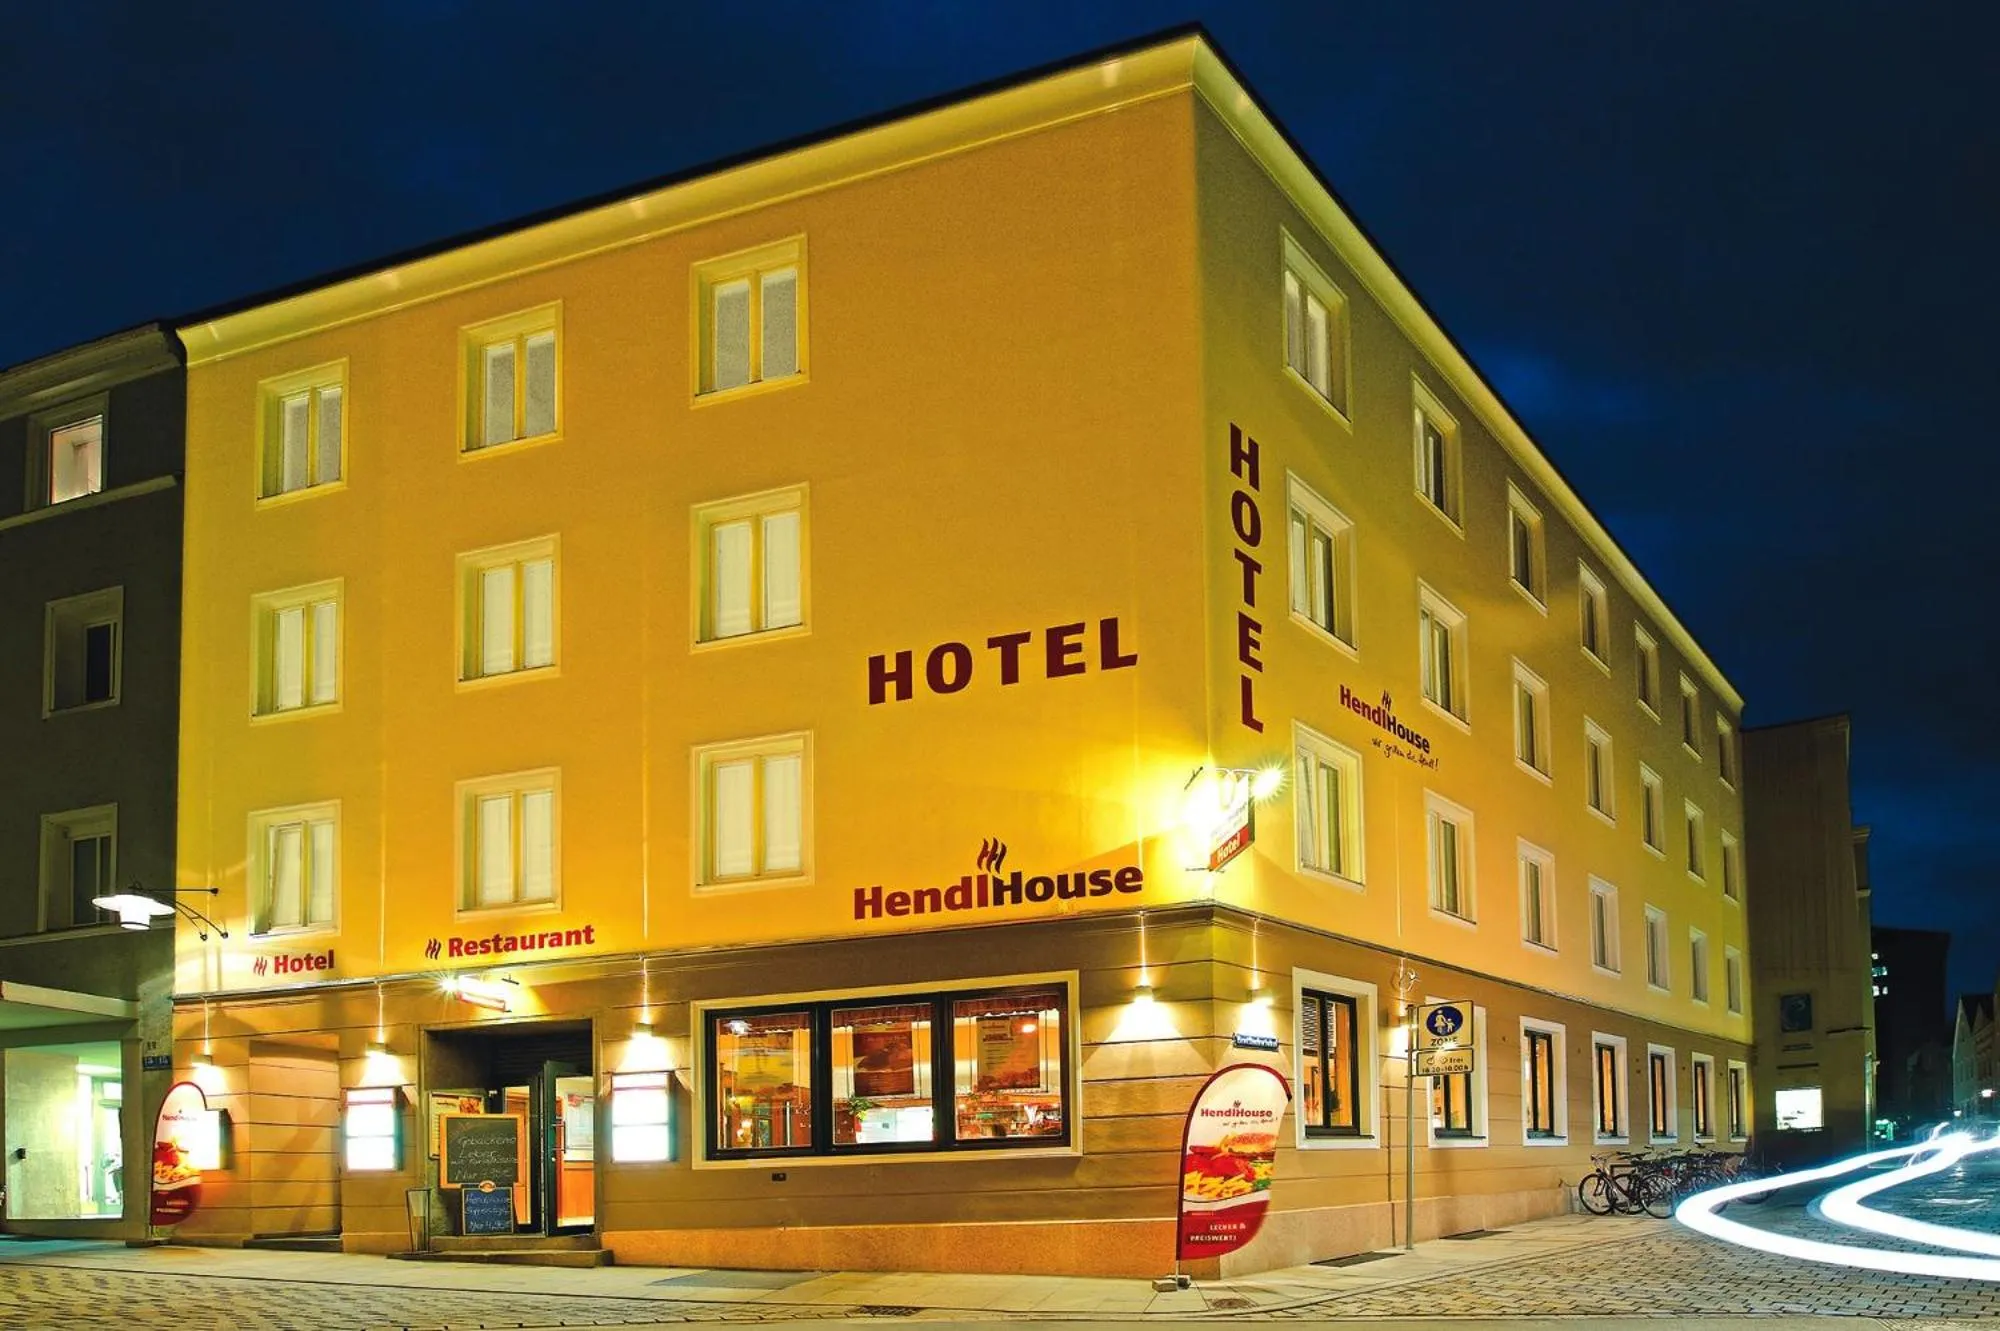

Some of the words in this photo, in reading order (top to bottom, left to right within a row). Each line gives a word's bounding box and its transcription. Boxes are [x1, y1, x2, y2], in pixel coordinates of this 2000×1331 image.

[1230, 422, 1264, 734] HOTEL
[868, 616, 1138, 705] HOTEL
[1339, 684, 1430, 754] HendlHouse
[1215, 831, 1241, 862] Hotel
[854, 865, 1144, 920] HendlHouse
[273, 949, 335, 974] Hotel
[448, 924, 596, 958] Restaurant
[1200, 1107, 1273, 1118] HendlHouse
